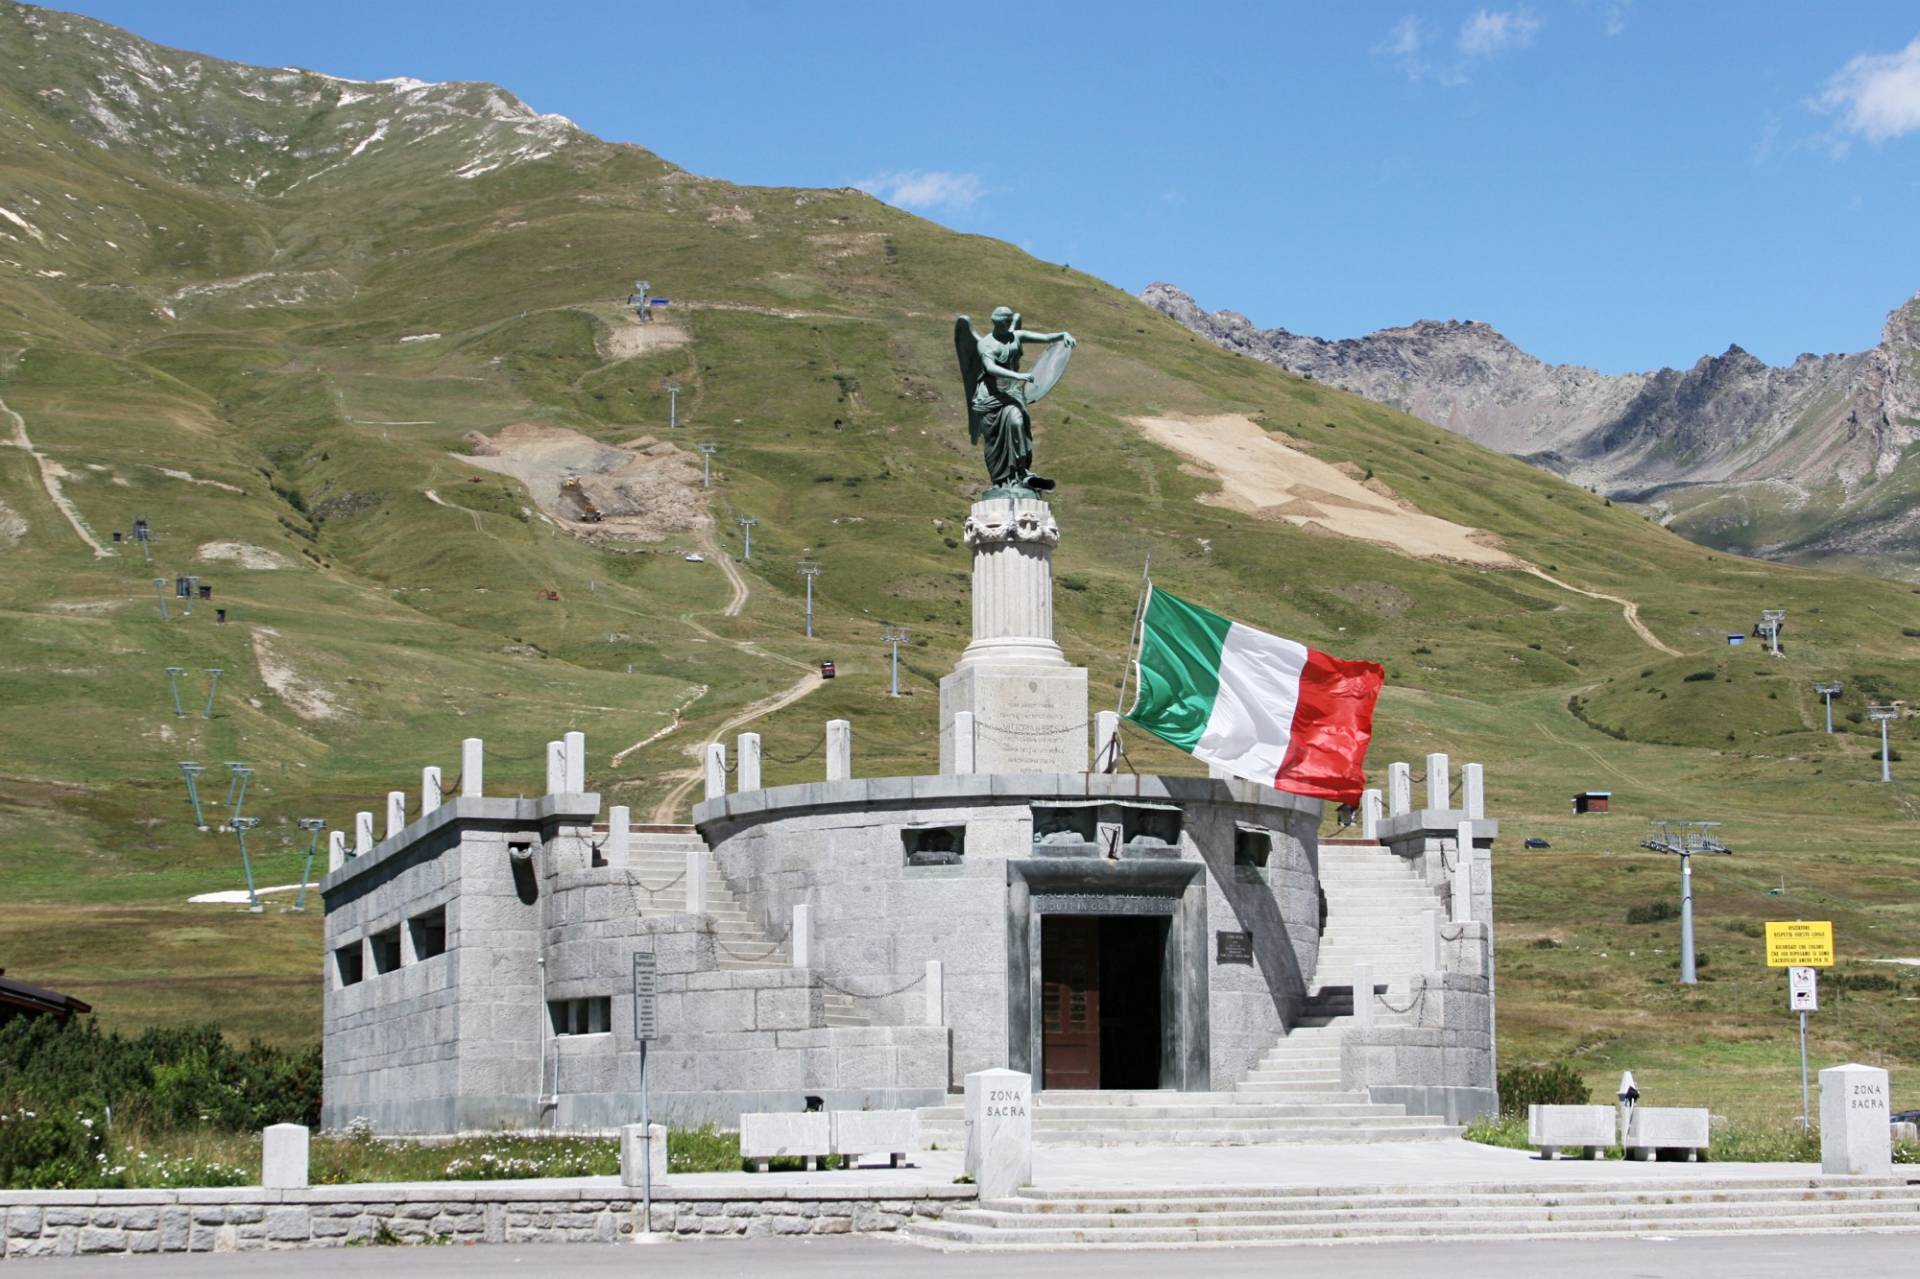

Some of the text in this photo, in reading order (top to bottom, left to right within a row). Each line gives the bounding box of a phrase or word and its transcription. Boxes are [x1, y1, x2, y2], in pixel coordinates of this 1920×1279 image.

[1854, 1084, 1881, 1095] ZONA
[990, 1090, 1021, 1101] ZONA
[1851, 1099, 1884, 1109] SACRA
[987, 1106, 1026, 1117] SACRA
